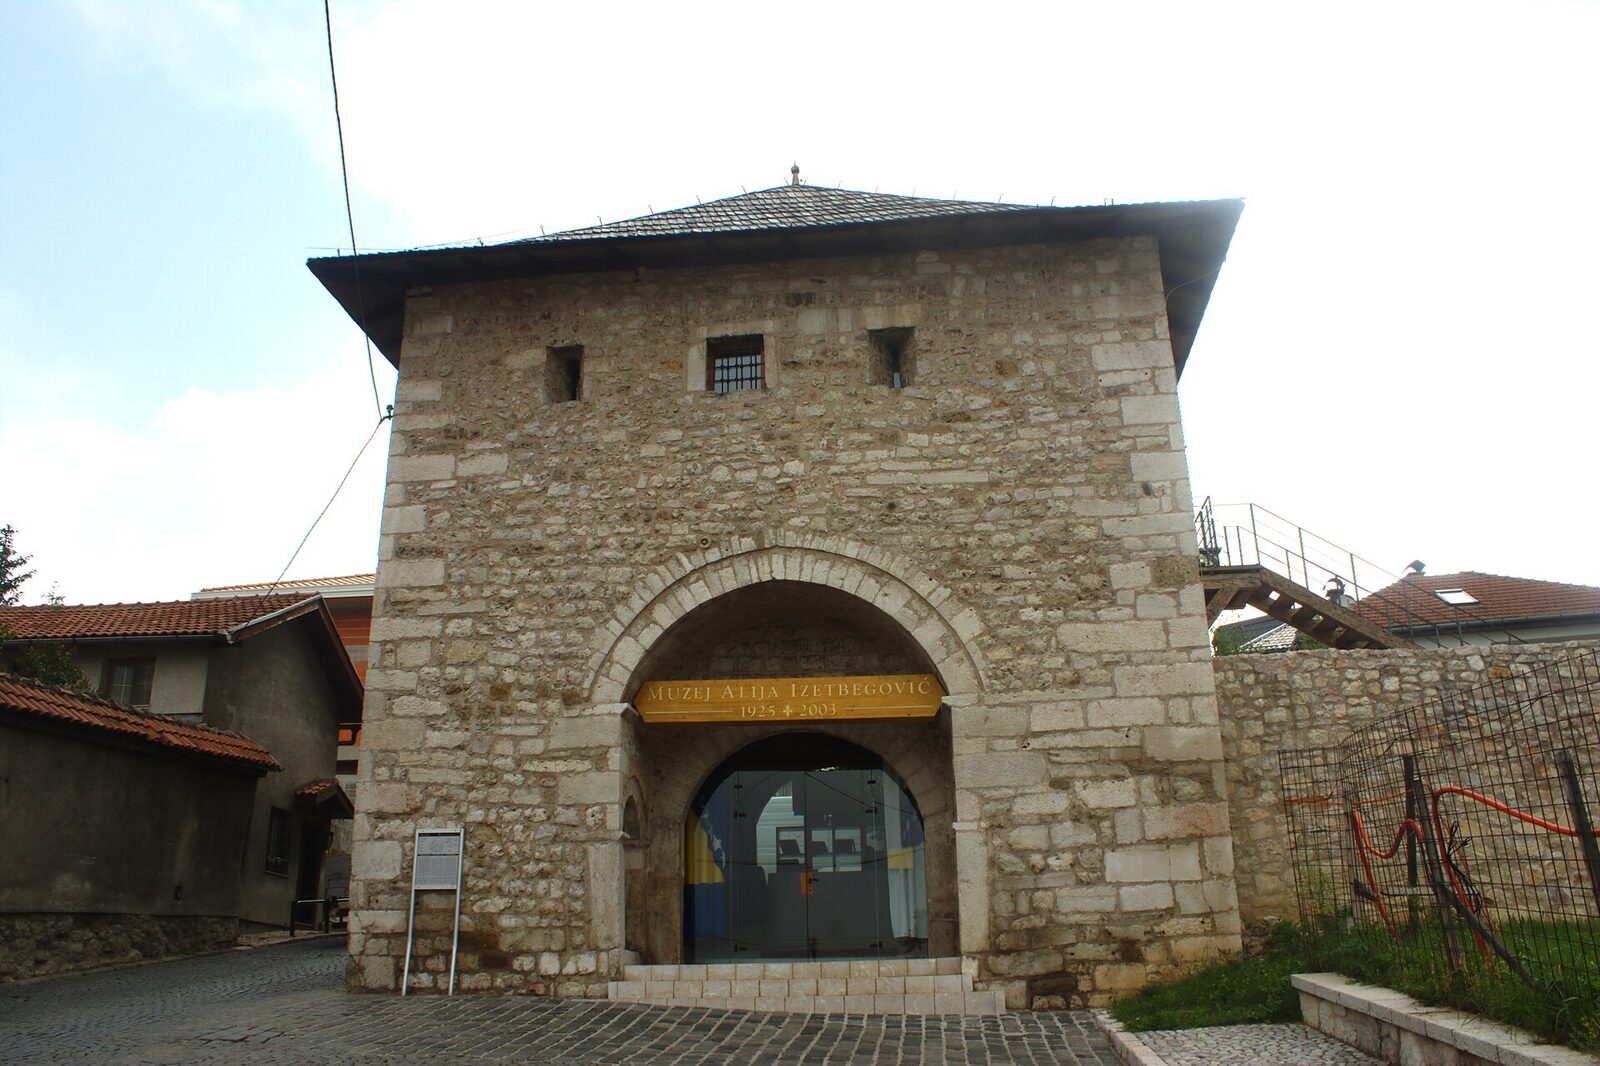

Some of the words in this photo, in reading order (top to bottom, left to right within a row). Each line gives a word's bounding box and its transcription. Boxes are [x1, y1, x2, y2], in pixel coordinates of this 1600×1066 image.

[649, 686, 710, 702] MUZEJ
[721, 685, 779, 701] ALIJA
[791, 677, 930, 698] IZETBEGOVIĆ
[741, 705, 776, 718] 1925
[799, 704, 836, 717] 2003
